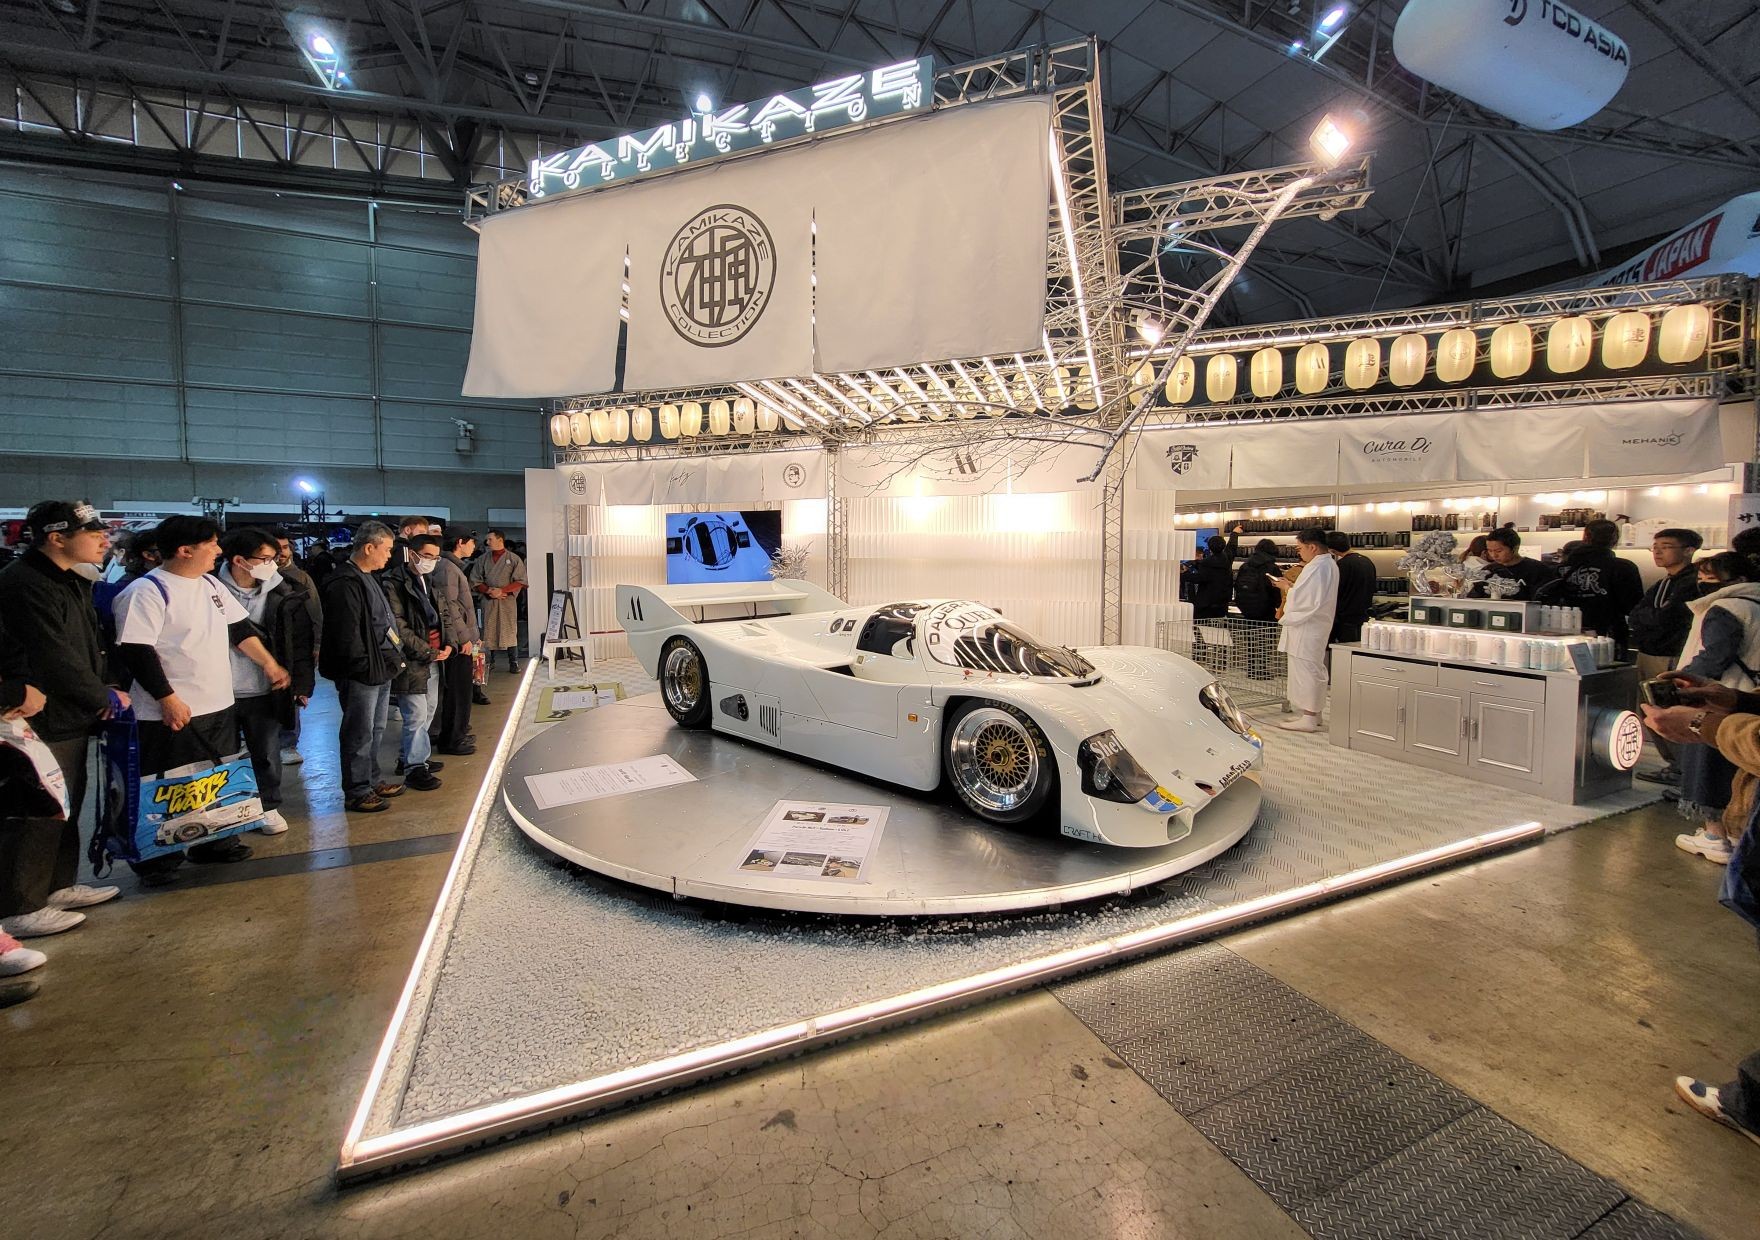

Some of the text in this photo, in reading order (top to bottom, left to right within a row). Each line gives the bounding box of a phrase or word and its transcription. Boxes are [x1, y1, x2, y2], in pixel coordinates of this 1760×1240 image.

[1583, 26, 1627, 66] ASIA
[530, 81, 922, 198] COLLECTION
[531, 58, 920, 187] KAMIKAZE
[666, 213, 768, 276] KAMIKAZE
[1645, 222, 1712, 281] JAPAN
[670, 290, 764, 339] COLLECTION
[1363, 440, 1406, 454] Cura
[154, 770, 228, 803] LIBERTY
[168, 784, 219, 814] WALK
[1063, 825, 1091, 838] CRAFT
